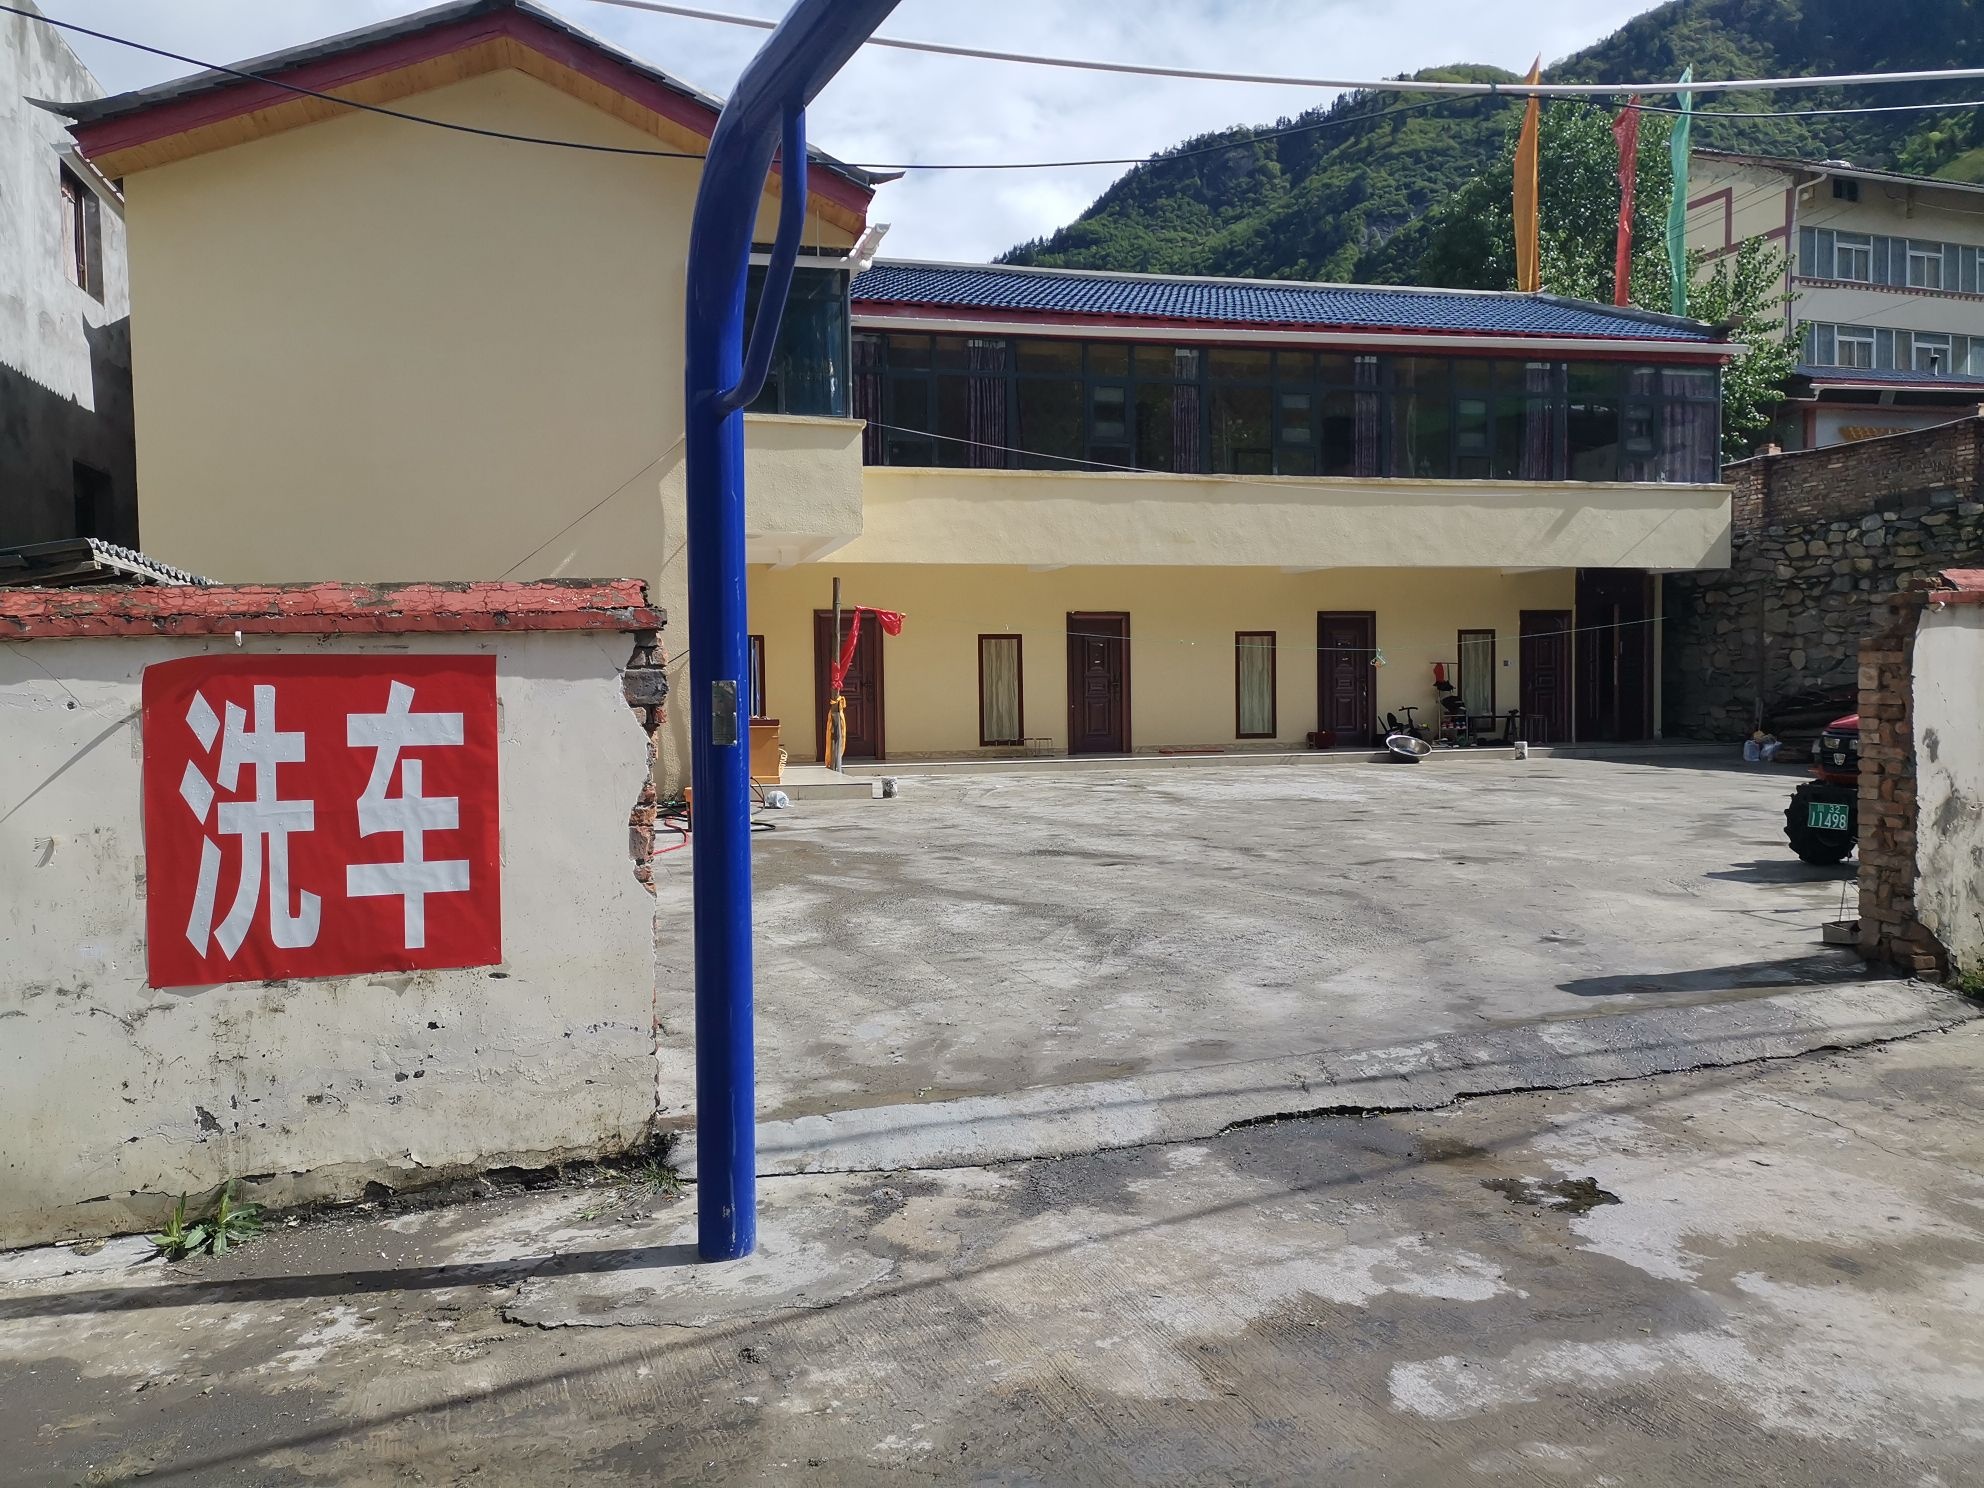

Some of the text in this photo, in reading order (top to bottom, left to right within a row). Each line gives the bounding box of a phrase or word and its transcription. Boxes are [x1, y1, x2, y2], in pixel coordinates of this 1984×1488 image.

[1829, 804, 1841, 813] 32
[180, 680, 470, 961] 洗车
[1811, 811, 1847, 829] 11498
